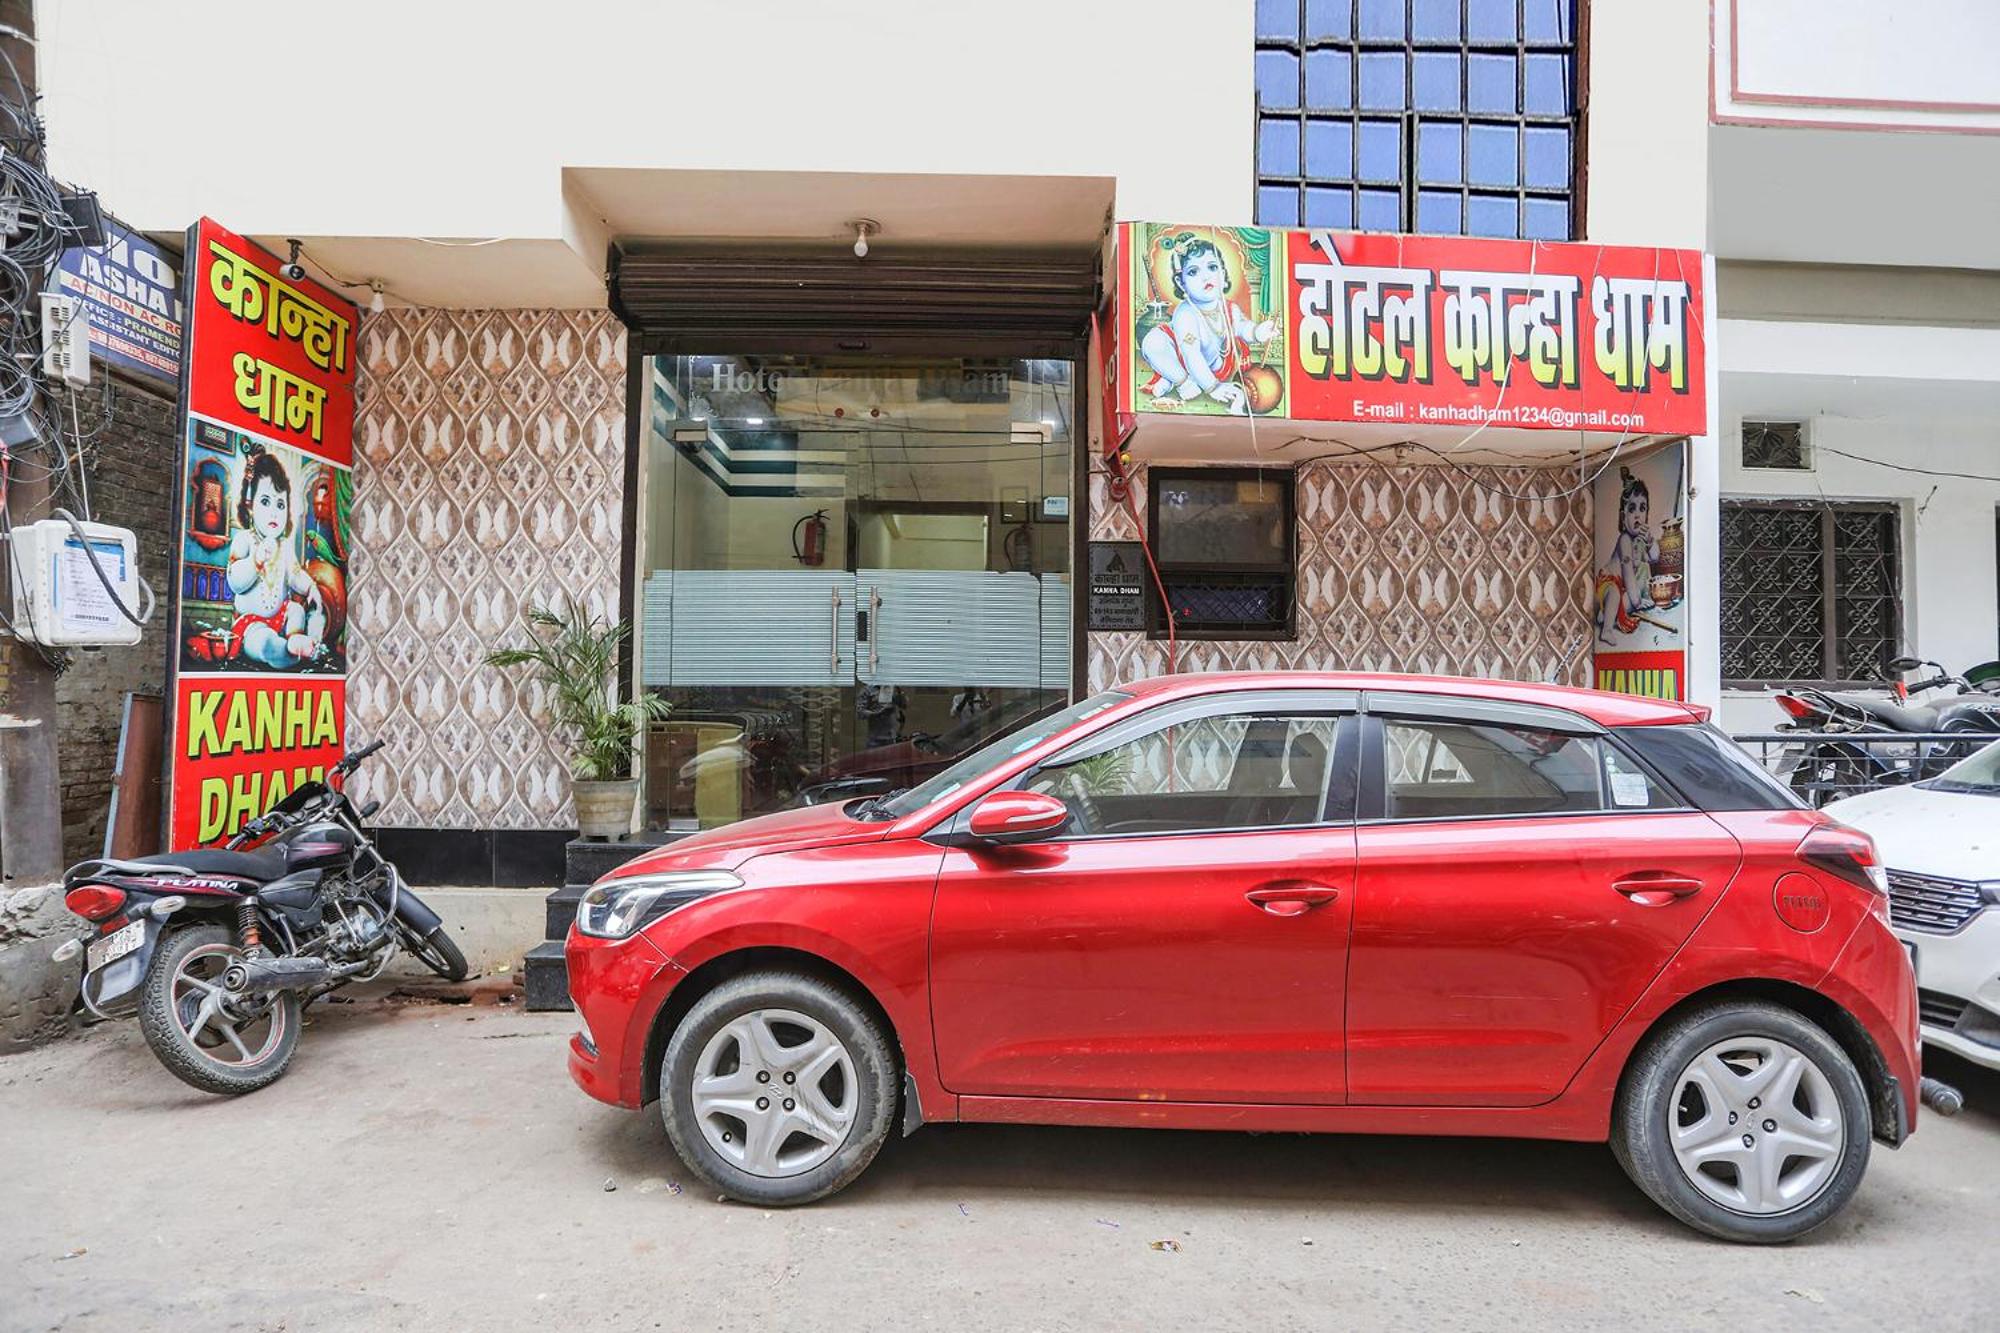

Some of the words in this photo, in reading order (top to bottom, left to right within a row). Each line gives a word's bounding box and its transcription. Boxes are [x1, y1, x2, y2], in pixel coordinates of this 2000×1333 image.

[140, 309, 160, 326] AC
[209, 239, 349, 372] कान्हा
[1294, 231, 1434, 382] होटल
[1439, 269, 1580, 388] कान्हा
[1591, 275, 1690, 390] धाम
[232, 352, 327, 442] धाम
[711, 362, 785, 393] Hote
[1353, 399, 1403, 418] E-mail
[1419, 403, 1644, 427] kanhadham1234@gmail.com
[187, 690, 339, 758] KANHA
[156, 878, 239, 890] PLATINA
